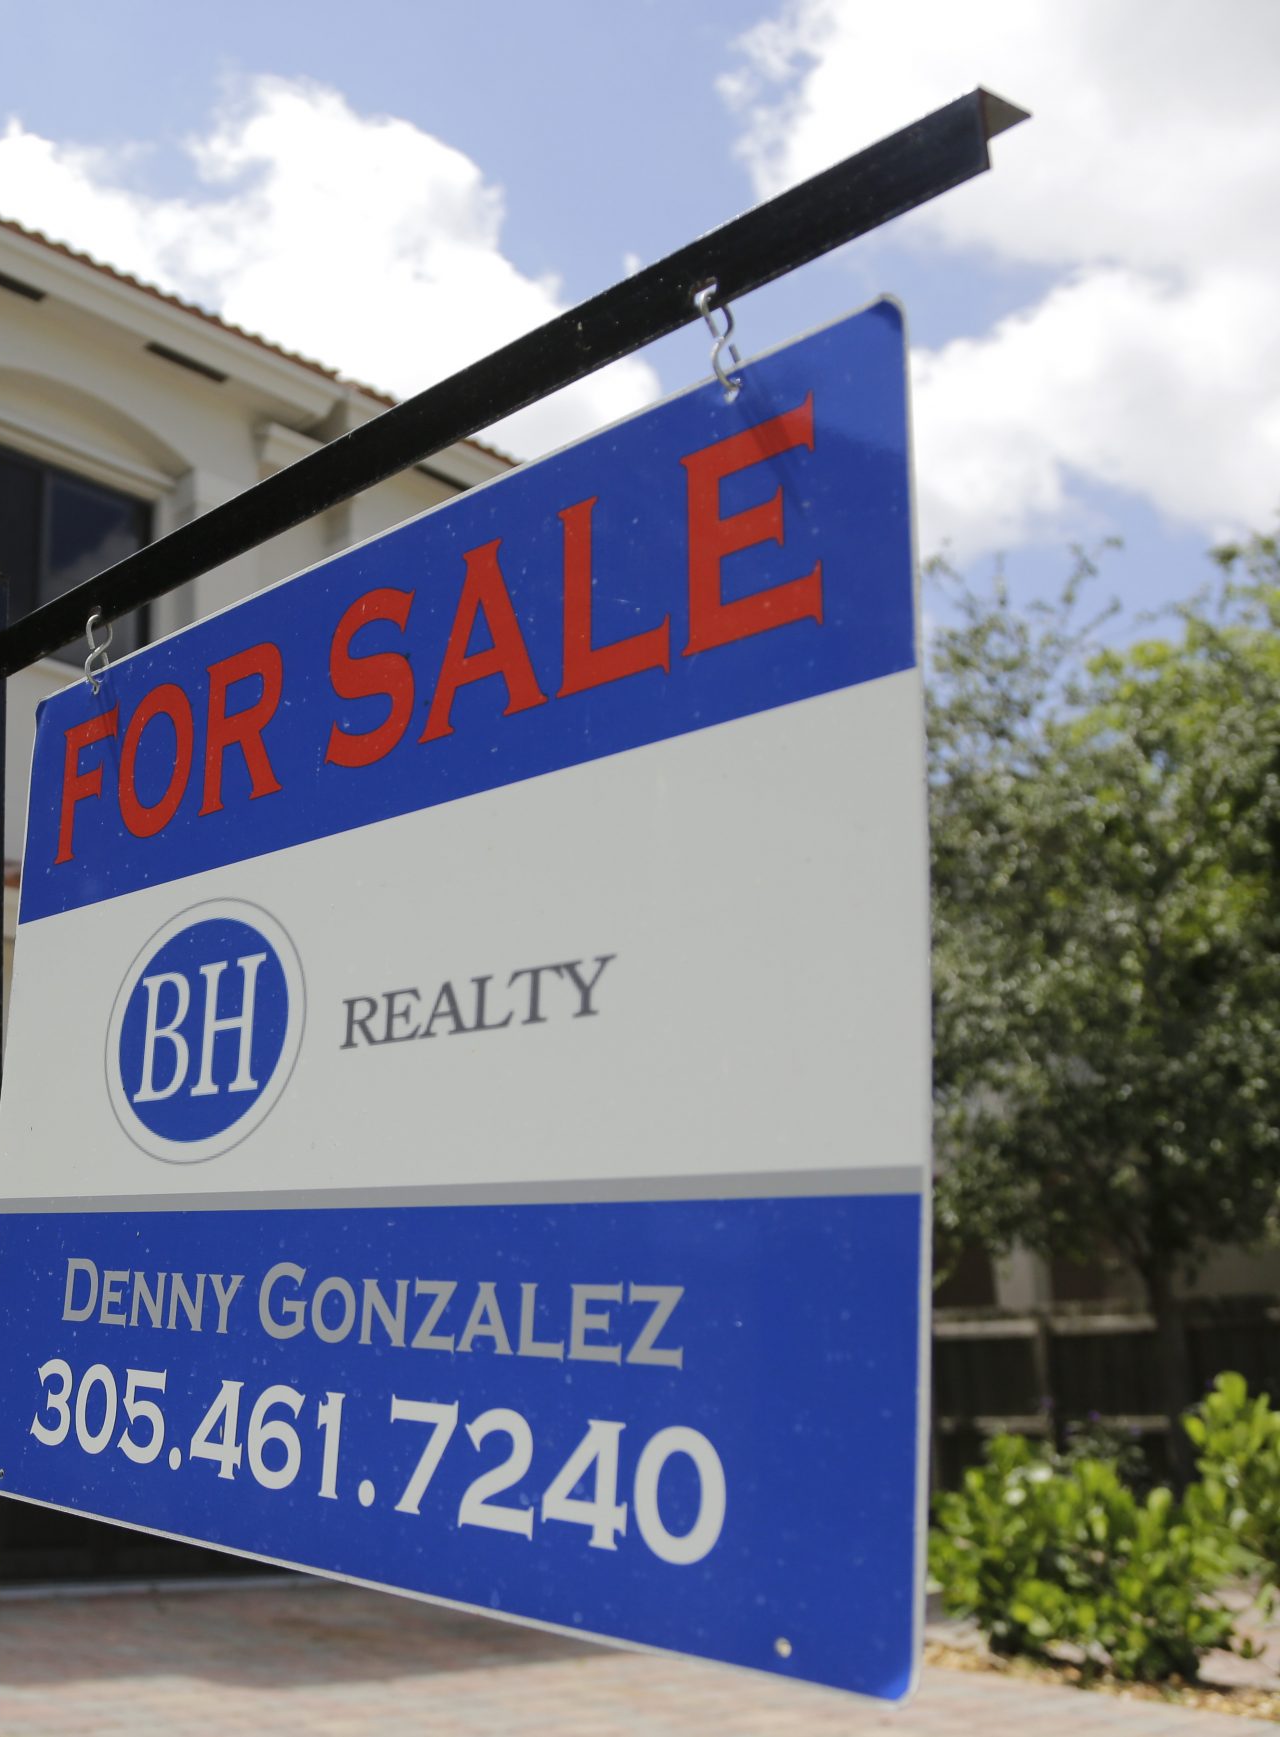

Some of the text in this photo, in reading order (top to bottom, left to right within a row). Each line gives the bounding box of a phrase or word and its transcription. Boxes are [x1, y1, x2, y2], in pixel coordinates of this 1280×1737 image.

[54, 390, 824, 865] FOR SALE
[133, 952, 617, 1103] BH REALTY
[61, 1257, 685, 1370] DENNY GONZALEZ
[30, 1358, 727, 1566] 305.461.7240
